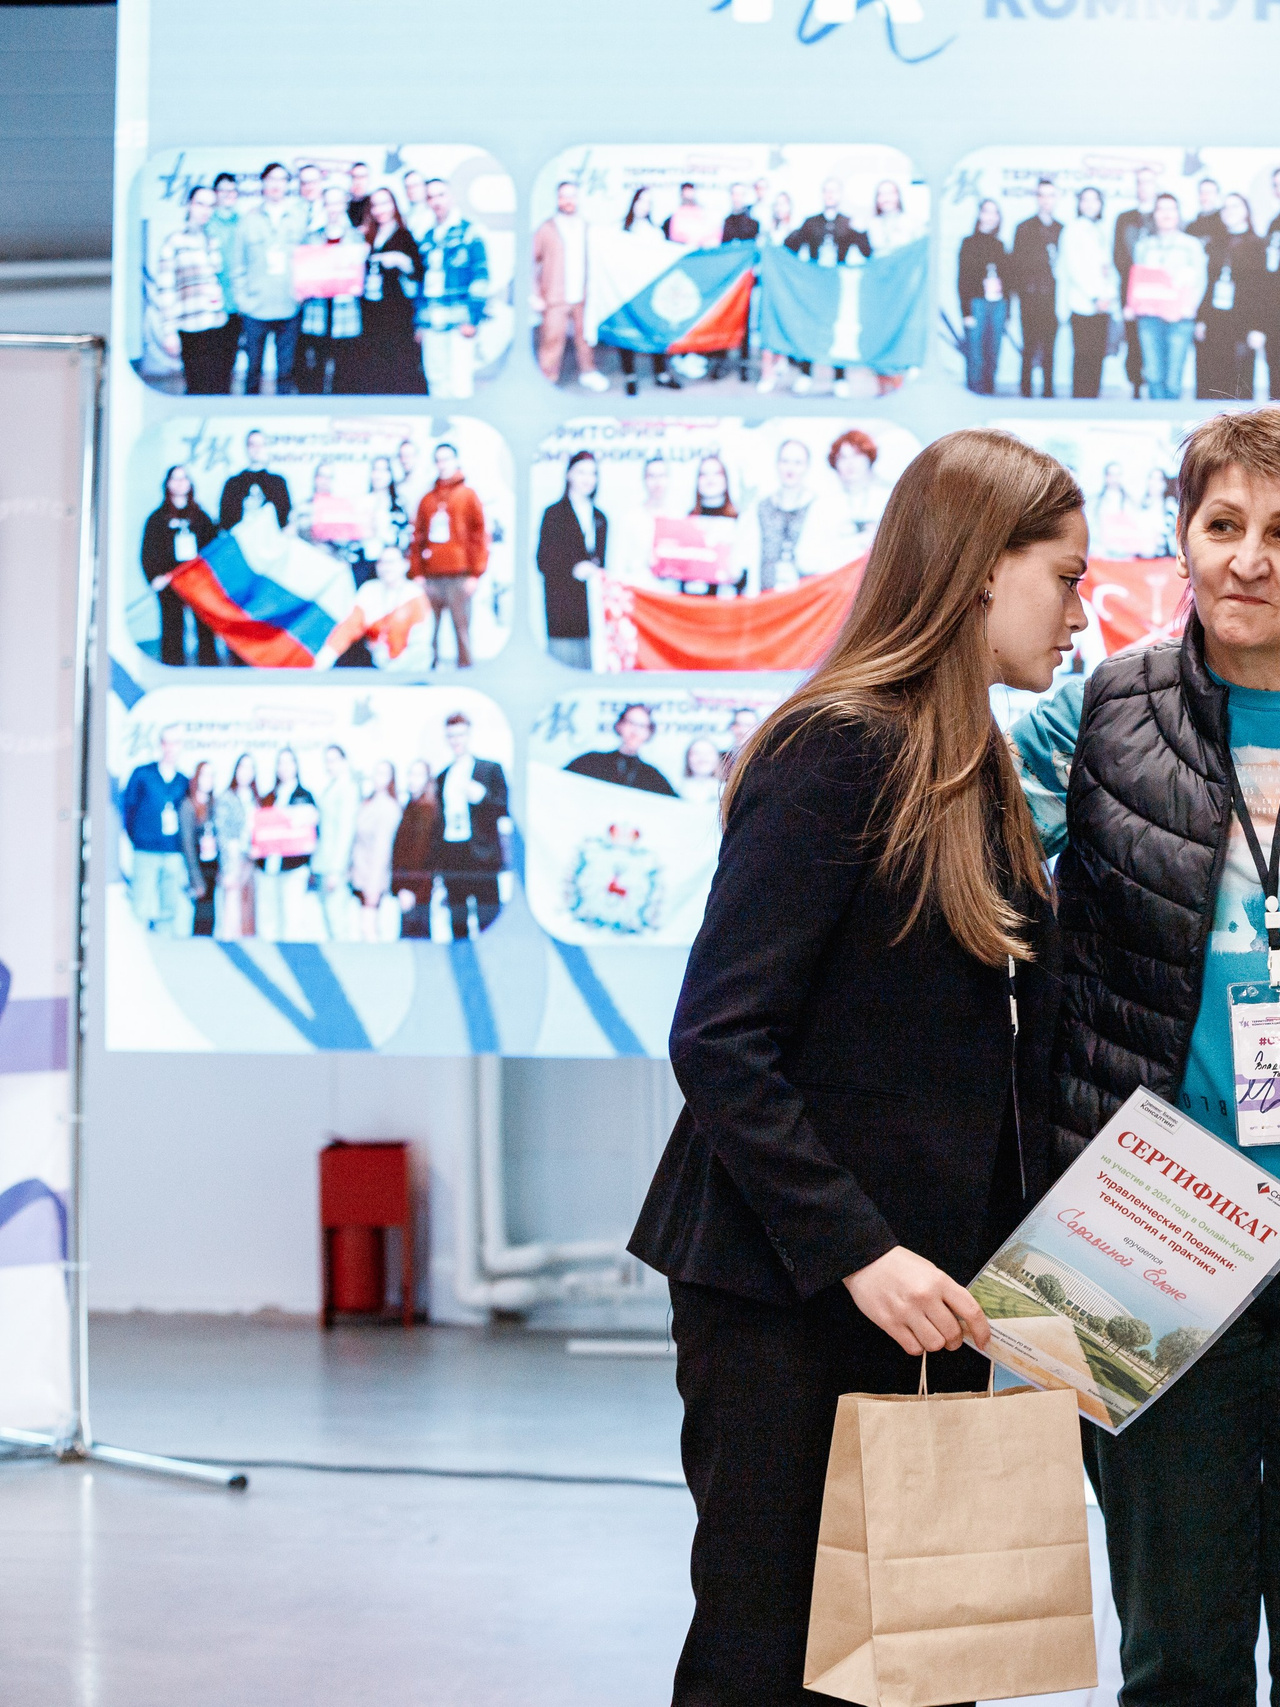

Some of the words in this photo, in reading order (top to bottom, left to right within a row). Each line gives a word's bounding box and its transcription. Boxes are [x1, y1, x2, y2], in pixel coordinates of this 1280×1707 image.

[1140, 1103, 1177, 1128] Консалтинг
[1097, 1170, 1182, 1235] Управленческие
[1182, 1230, 1238, 1272] Поединки:
[1101, 1154, 1113, 1165] на
[1111, 1161, 1144, 1186] участие
[1145, 1184, 1152, 1192] в
[1151, 1188, 1173, 1205] 2024
[1171, 1203, 1192, 1221] году
[1198, 1220, 1256, 1263] Онлайн-Курсе
[1118, 1131, 1278, 1244] СЕРТИФИКАТ
[1099, 1191, 1160, 1237] технология
[1159, 1233, 1168, 1243] и
[1168, 1240, 1217, 1276] практика
[1123, 1237, 1165, 1266] вручается
[1143, 1269, 1188, 1303] Елене
